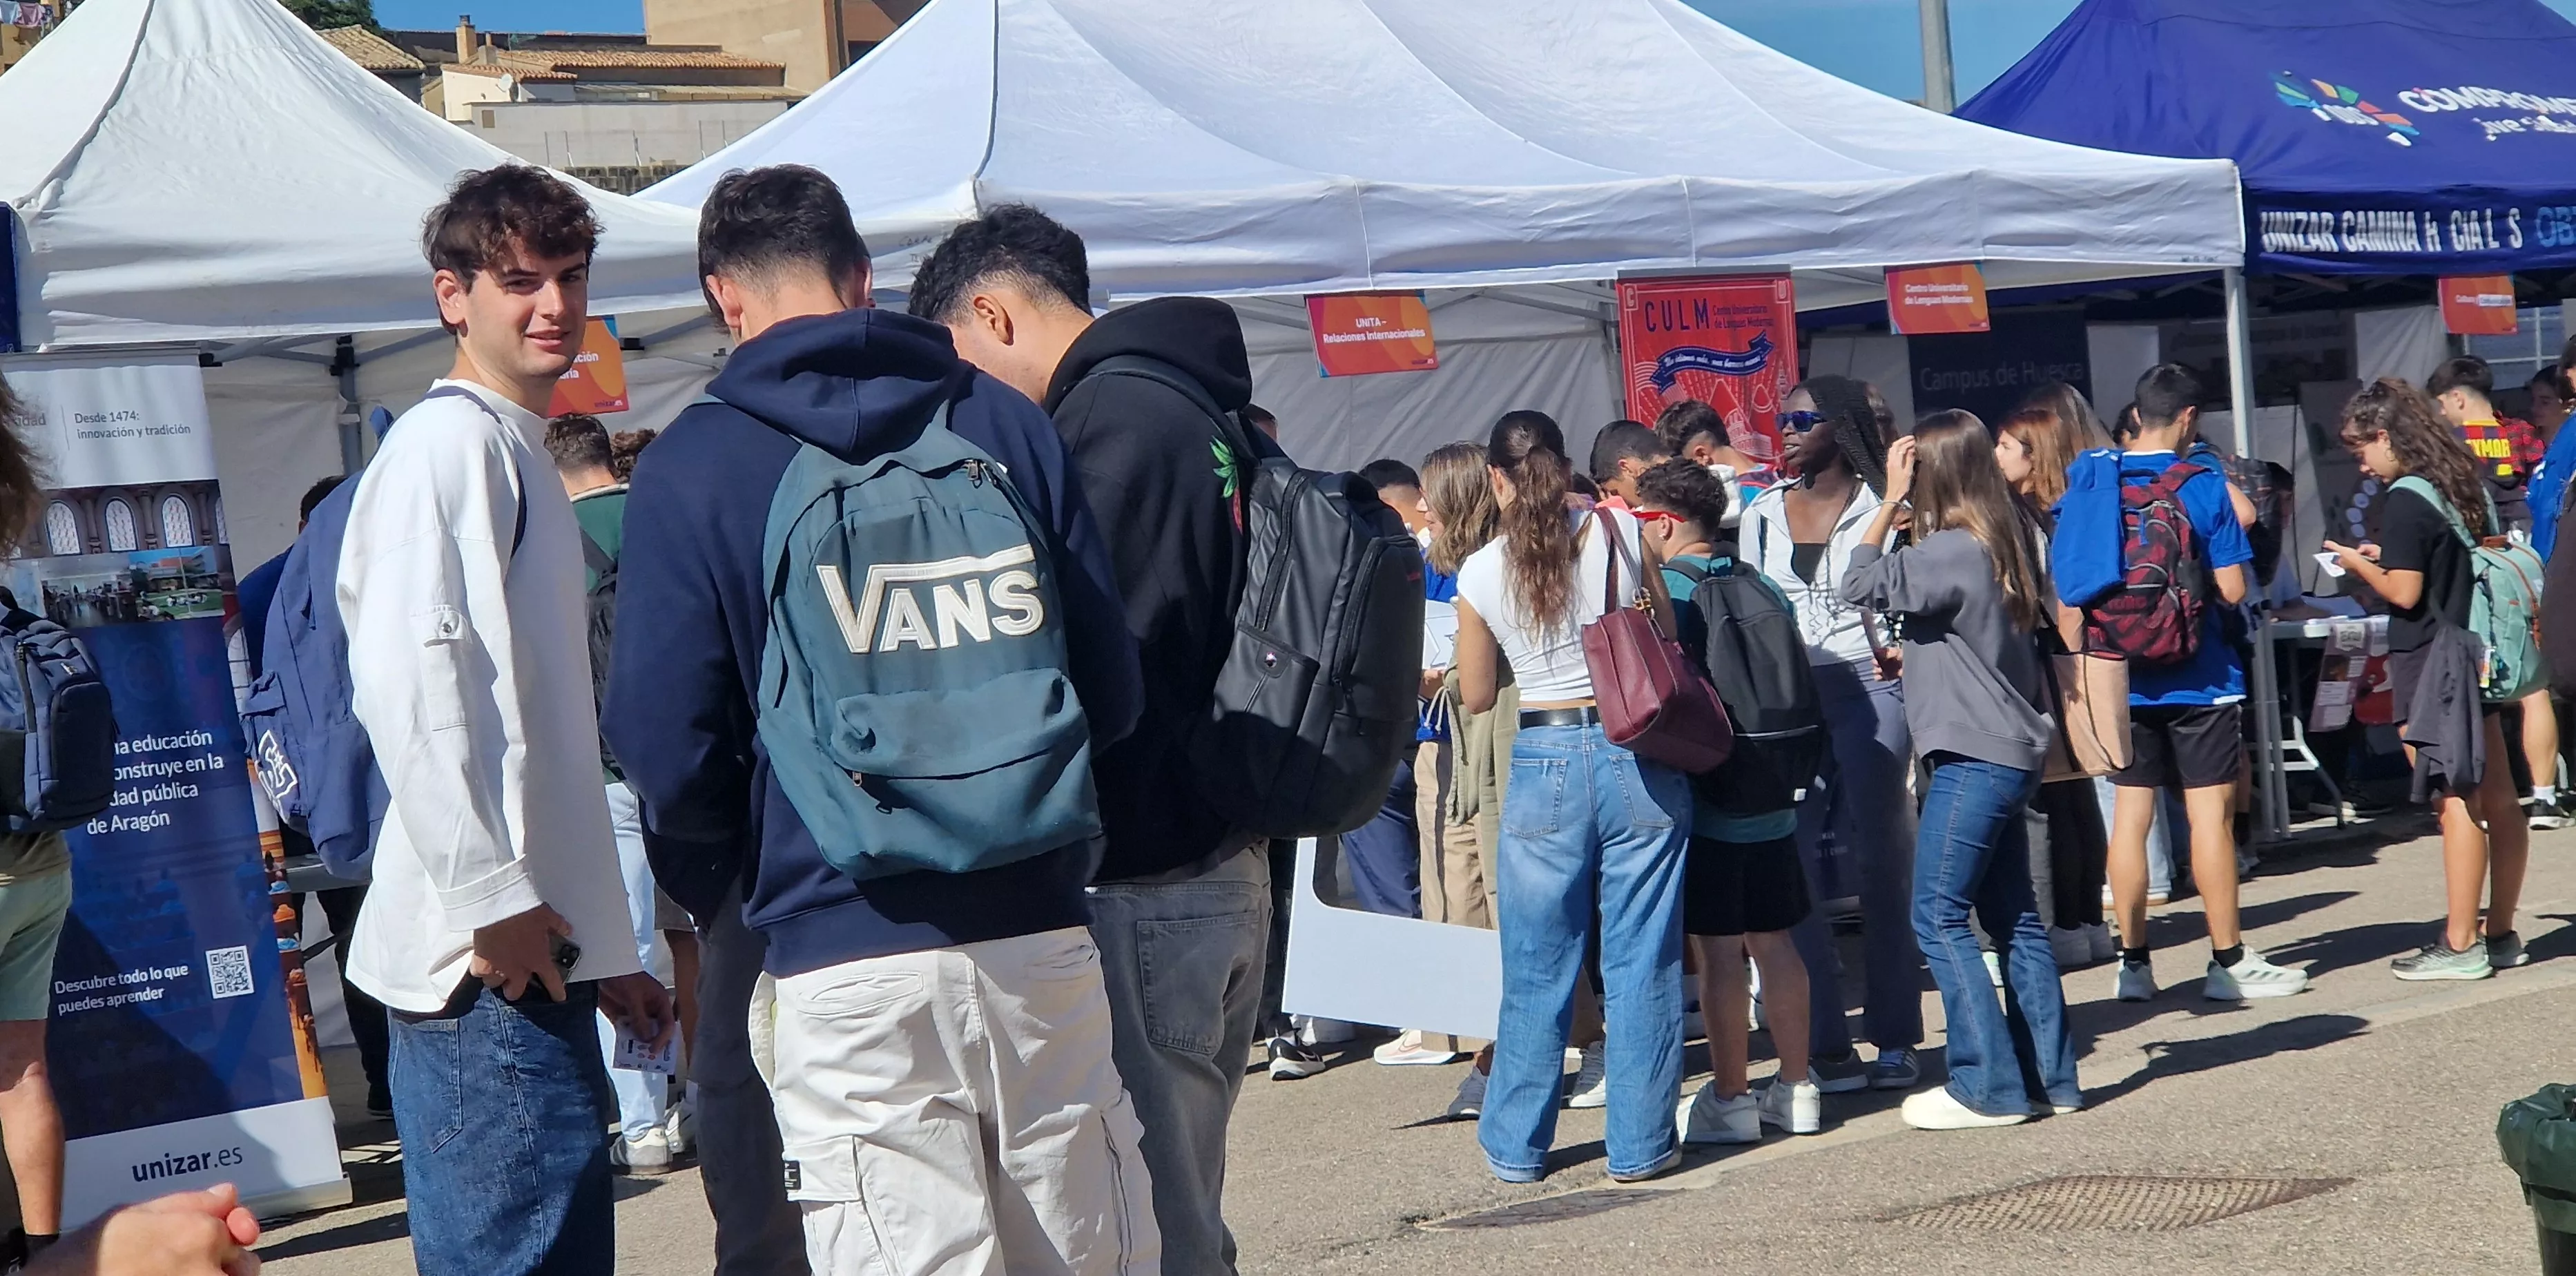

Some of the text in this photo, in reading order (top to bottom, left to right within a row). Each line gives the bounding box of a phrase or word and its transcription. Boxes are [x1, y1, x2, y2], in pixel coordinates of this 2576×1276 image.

[2260, 211, 2339, 253] UNIZAR
[2342, 210, 2421, 253] CAMINA
[2424, 209, 2484, 253] HCIA
[2535, 206, 2576, 249] OB
[1355, 317, 1381, 328] UNITA
[1645, 298, 1710, 332] CULM
[1323, 328, 1426, 343] Relaciones Internacionales
[1920, 360, 2083, 394] Campus de Huesca
[75, 411, 139, 424] Desde 1474:
[77, 423, 191, 440] innovación y tradición
[2464, 438, 2511, 458] YMAR
[816, 543, 1045, 654] VANS
[133, 729, 212, 752] educación
[185, 757, 206, 771] en
[207, 753, 224, 770] la
[142, 782, 198, 806] pública
[87, 811, 171, 835] de Aragón
[55, 964, 189, 994] Descubre todo lo que
[58, 986, 166, 1016] puedes aprender
[131, 1146, 243, 1182] unizar.es
